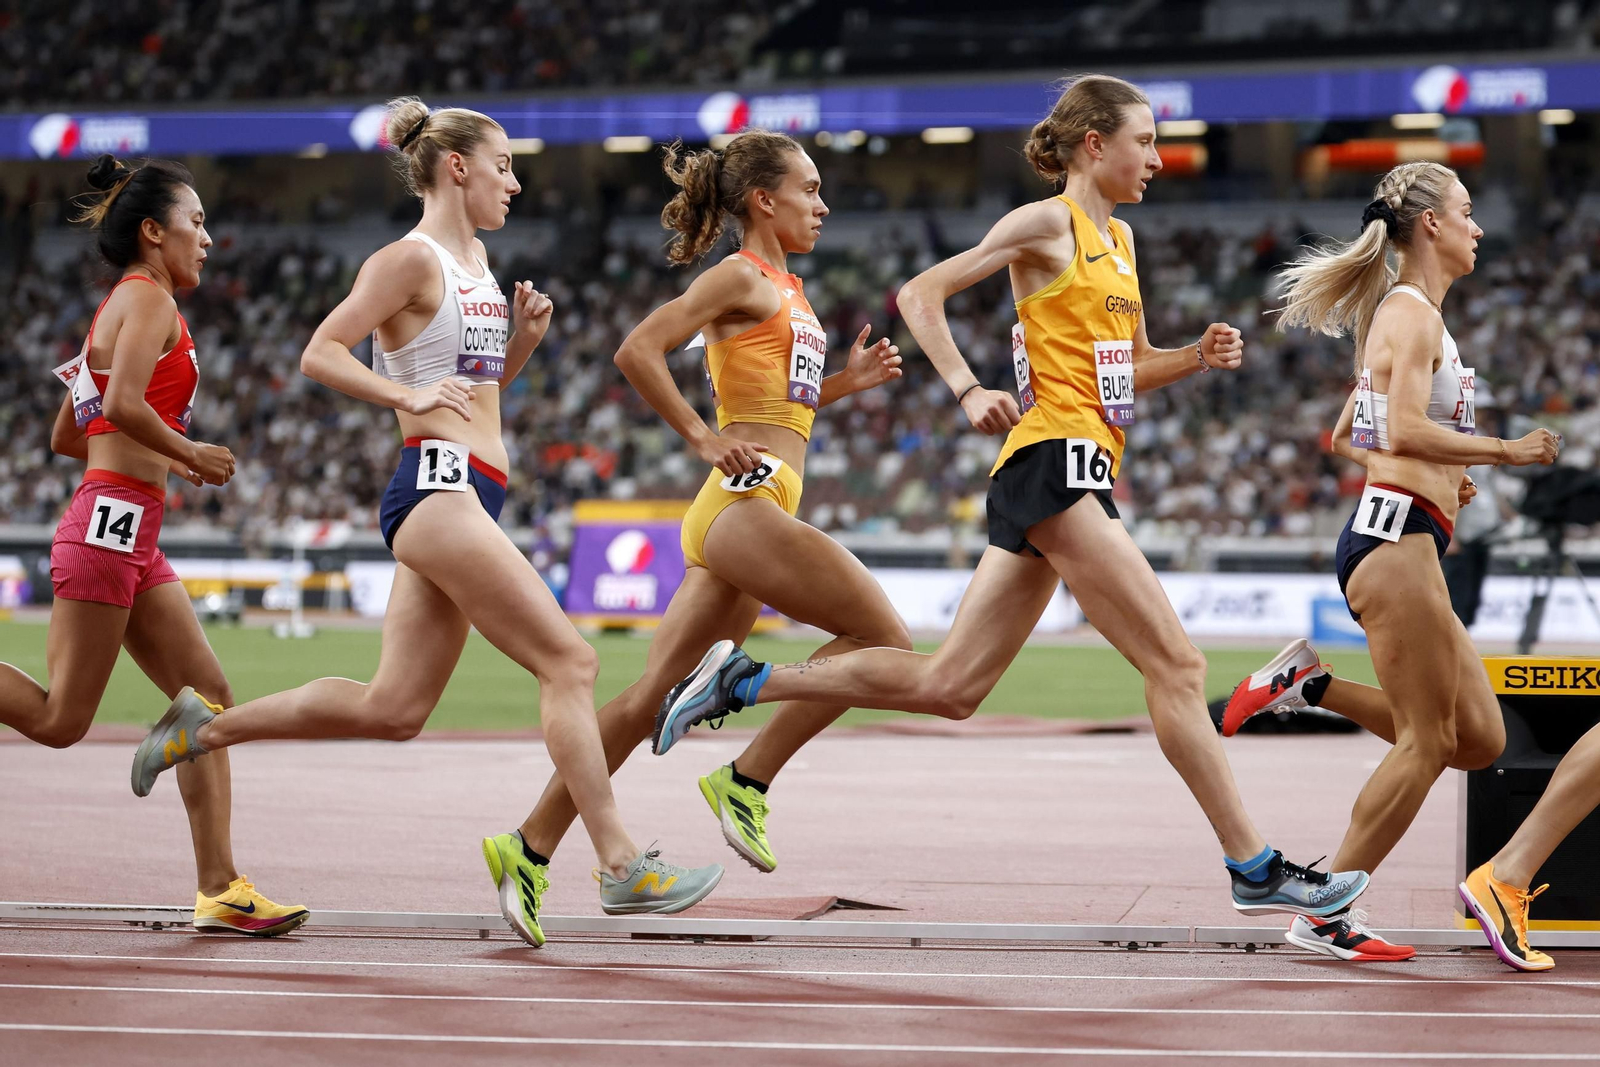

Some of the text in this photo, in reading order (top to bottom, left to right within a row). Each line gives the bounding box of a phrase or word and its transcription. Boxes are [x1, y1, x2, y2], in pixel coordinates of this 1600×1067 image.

[425, 448, 461, 484] 13
[1071, 445, 1107, 482] 16
[96, 505, 133, 545] 14
[1367, 496, 1400, 533] 11
[1504, 665, 1600, 689] SEIK
[1308, 880, 1352, 905] HOKA
